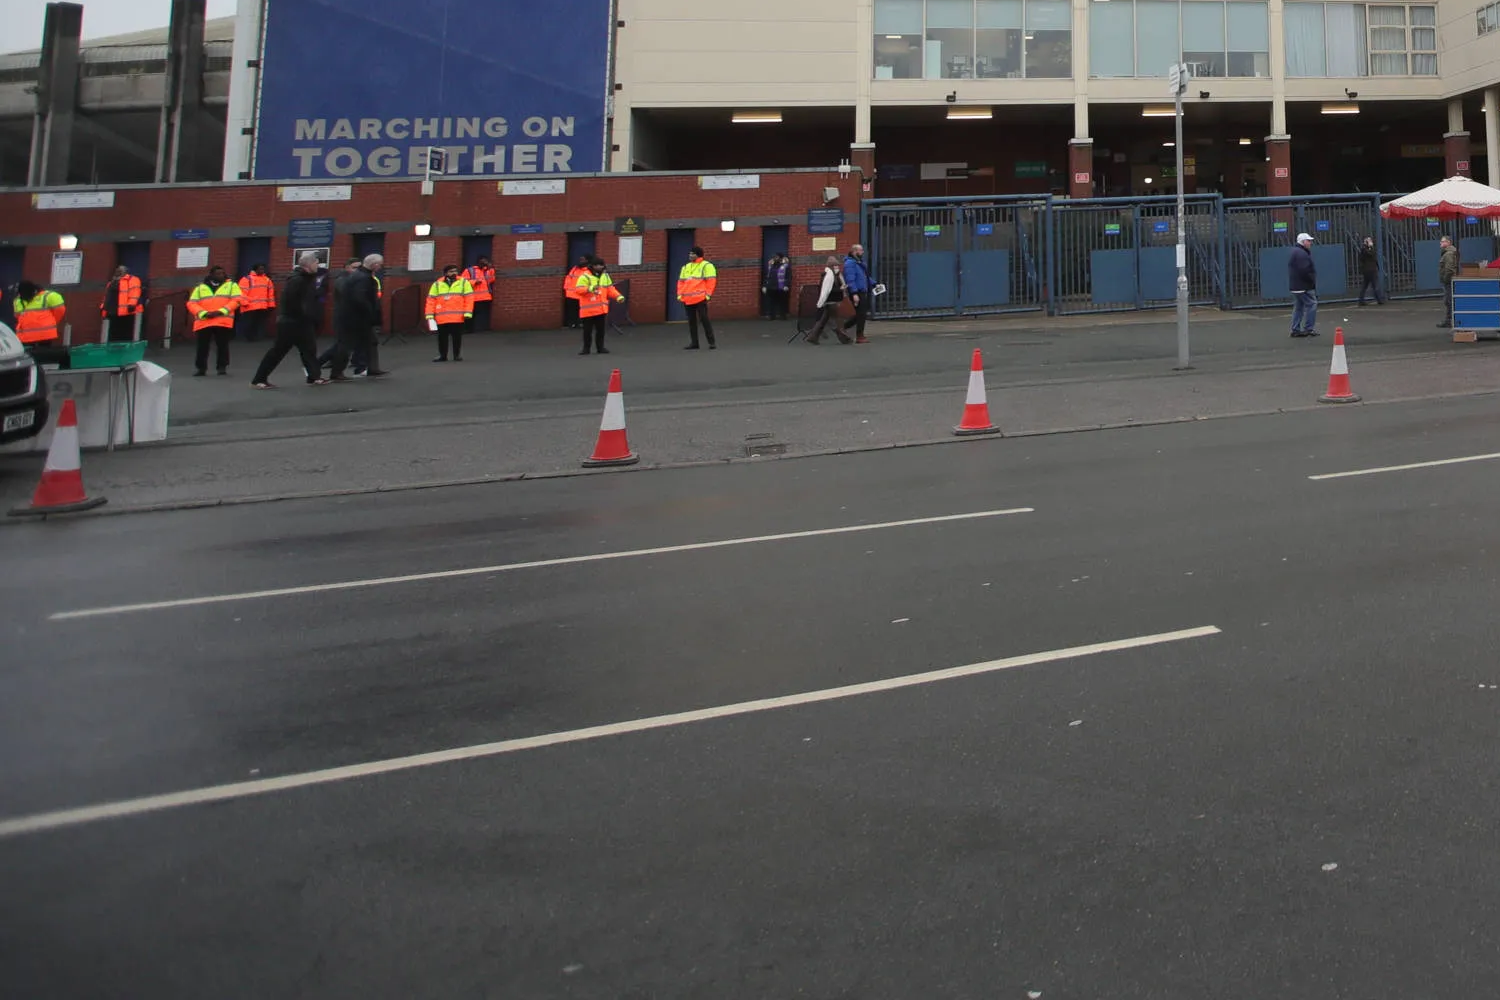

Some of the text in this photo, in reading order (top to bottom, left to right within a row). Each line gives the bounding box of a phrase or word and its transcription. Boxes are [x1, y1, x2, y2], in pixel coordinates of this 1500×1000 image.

[294, 116, 575, 140] MARCHING ON
[292, 144, 573, 177] TOGETHER
